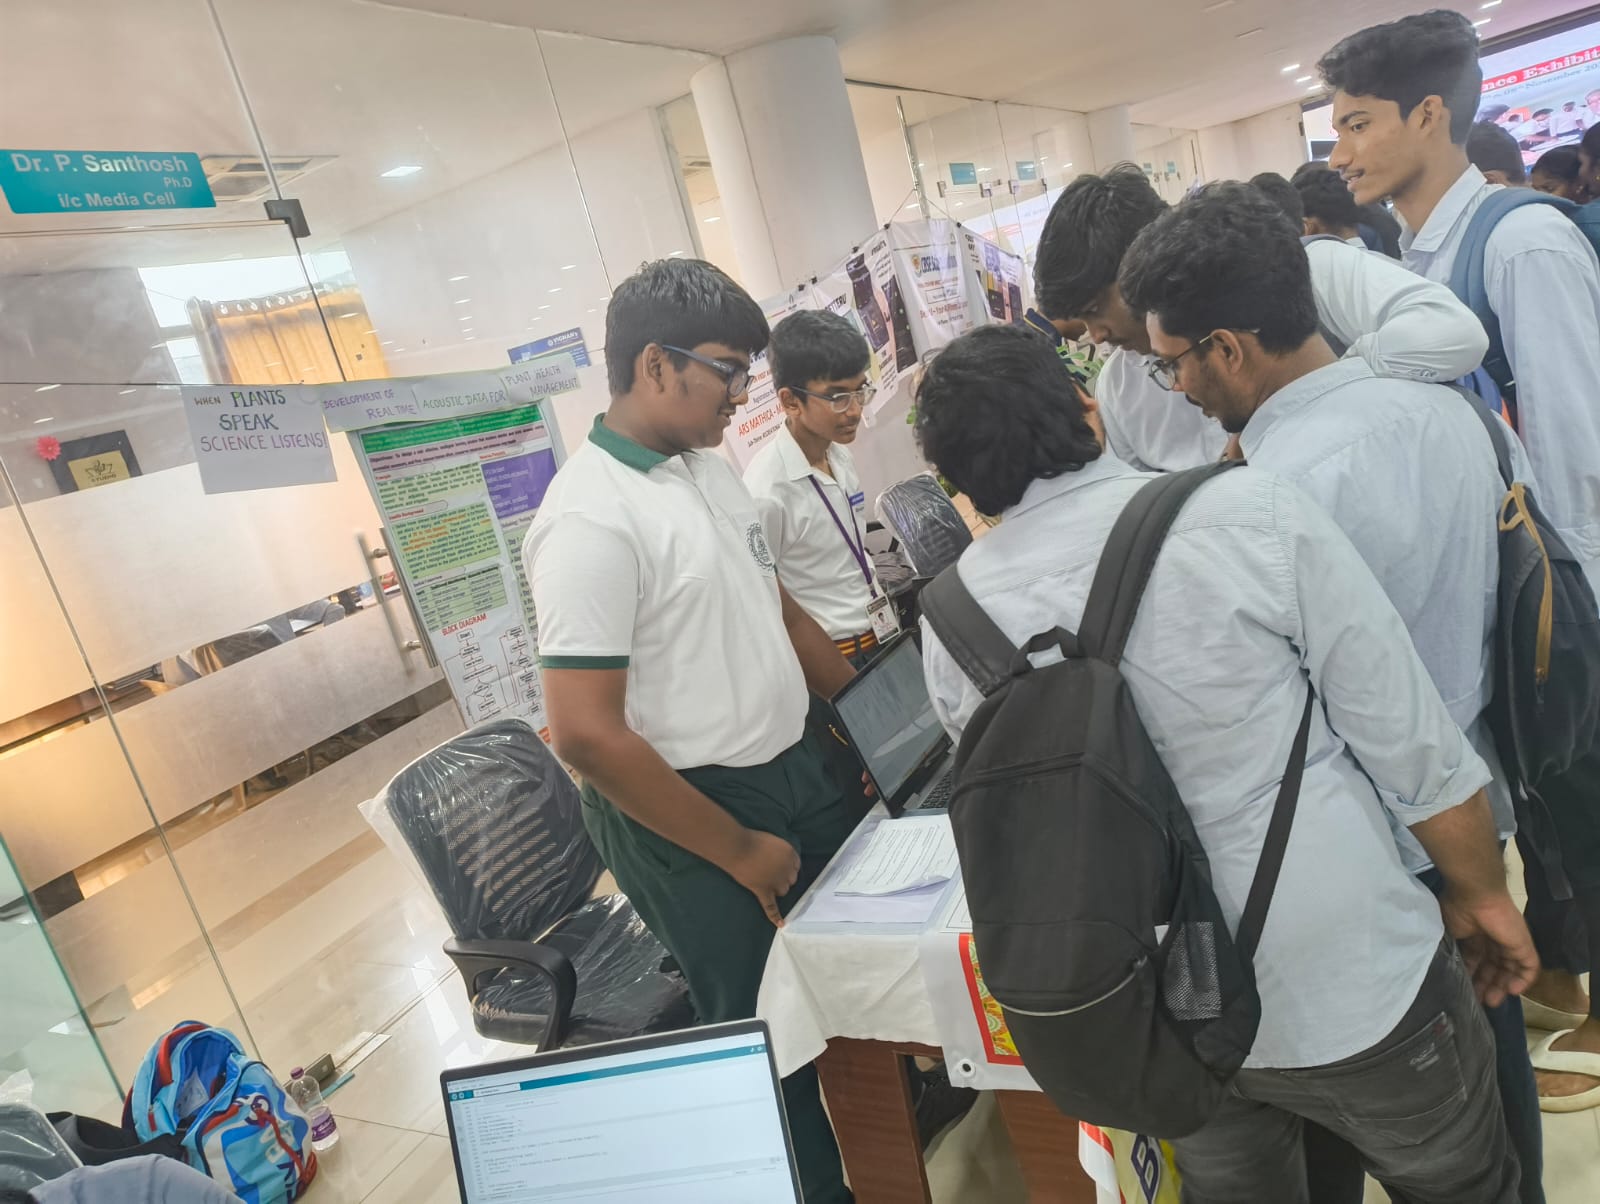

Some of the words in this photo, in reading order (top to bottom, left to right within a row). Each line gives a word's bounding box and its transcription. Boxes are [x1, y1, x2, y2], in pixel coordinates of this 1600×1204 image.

[11, 153, 49, 172] Dr.
[54, 154, 79, 172] P.
[82, 154, 189, 173] Santhosh
[163, 177, 193, 188] Ph.D
[85, 193, 140, 207] Media
[144, 192, 176, 205] Cell
[505, 371, 531, 385] PLANT
[529, 377, 577, 398] MANAGEMENT
[193, 396, 221, 406] WHEN
[231, 390, 287, 408] PLANTS
[323, 391, 382, 410] DEVELOPMENT
[384, 388, 395, 399] OF
[423, 395, 465, 409] ACOUSTIC
[465, 392, 487, 405] DATA
[489, 390, 506, 403] FOR
[219, 413, 280, 431] SPEAK
[366, 406, 394, 420] REAL
[200, 435, 267, 453] SCIENCE
[442, 624, 458, 636] BLOCK
[459, 612, 487, 629] DIAGRAM
